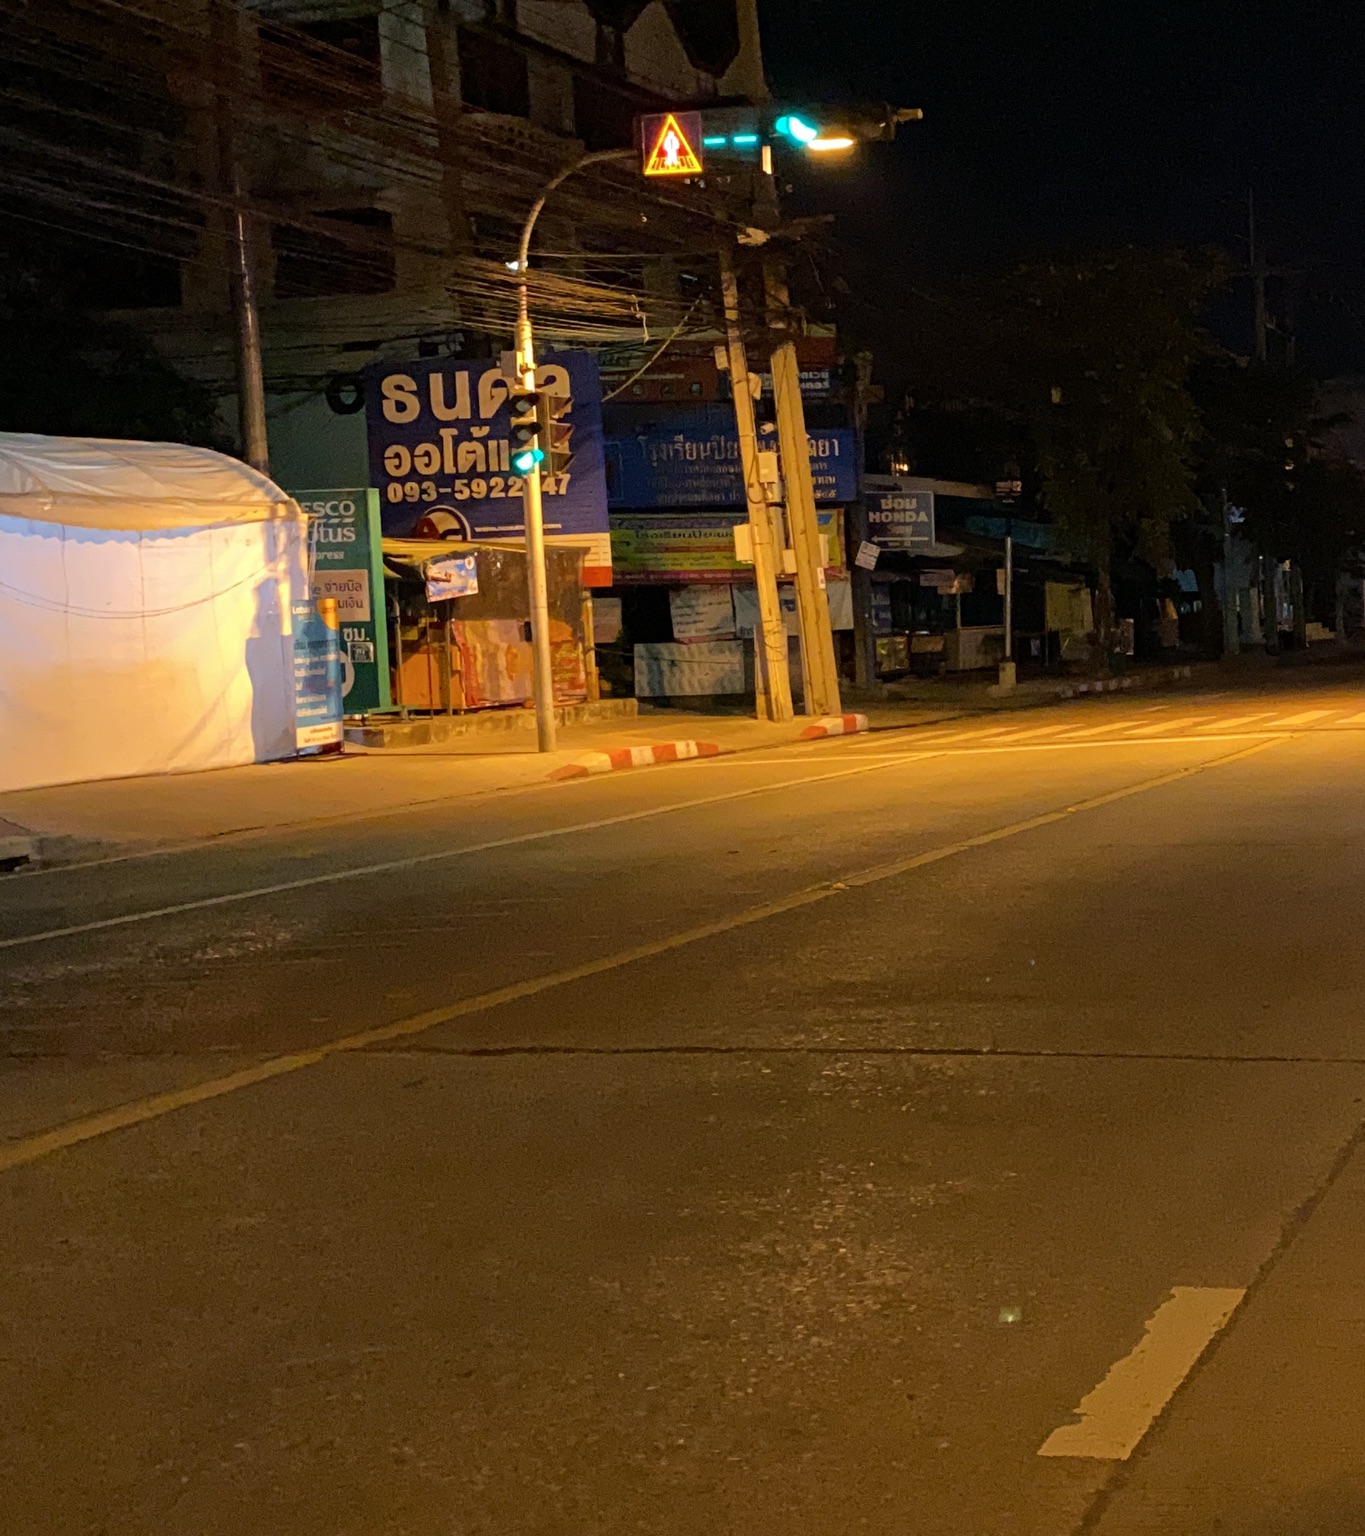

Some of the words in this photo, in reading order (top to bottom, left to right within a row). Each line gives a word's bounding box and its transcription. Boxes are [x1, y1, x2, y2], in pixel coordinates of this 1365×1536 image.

[387, 473, 571, 503] 093-592247
[301, 500, 355, 517] ESCO
[868, 511, 929, 523] HONDA
[316, 551, 345, 561] press
